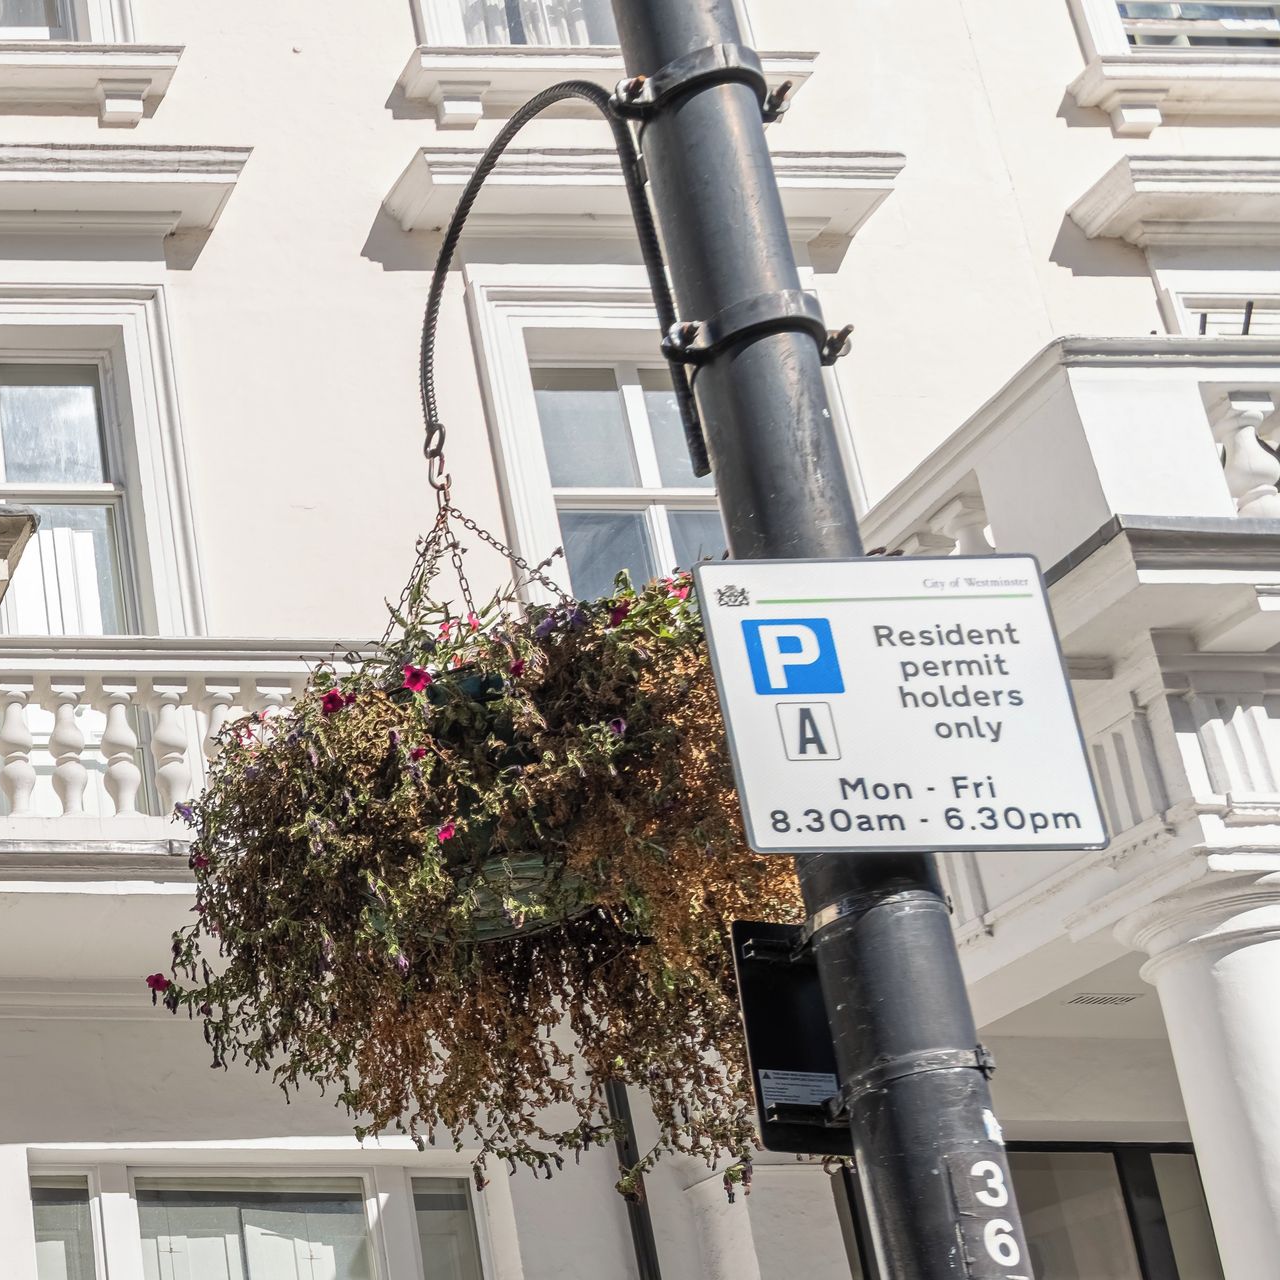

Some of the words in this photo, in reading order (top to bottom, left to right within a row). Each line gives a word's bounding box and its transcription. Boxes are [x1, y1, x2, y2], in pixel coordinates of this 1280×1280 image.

[922, 578, 945, 591] City
[949, 577, 960, 588] of
[963, 577, 1029, 588] Westminster
[873, 622, 1020, 648] Resident
[757, 624, 820, 689] P
[900, 654, 1009, 682] permit
[898, 686, 1024, 708] holders
[798, 707, 828, 755] A
[935, 715, 1003, 743] only
[839, 777, 913, 801] Mon
[951, 776, 997, 800] Fri
[770, 809, 906, 833] 8.30am
[944, 806, 1082, 834] 6.30pm
